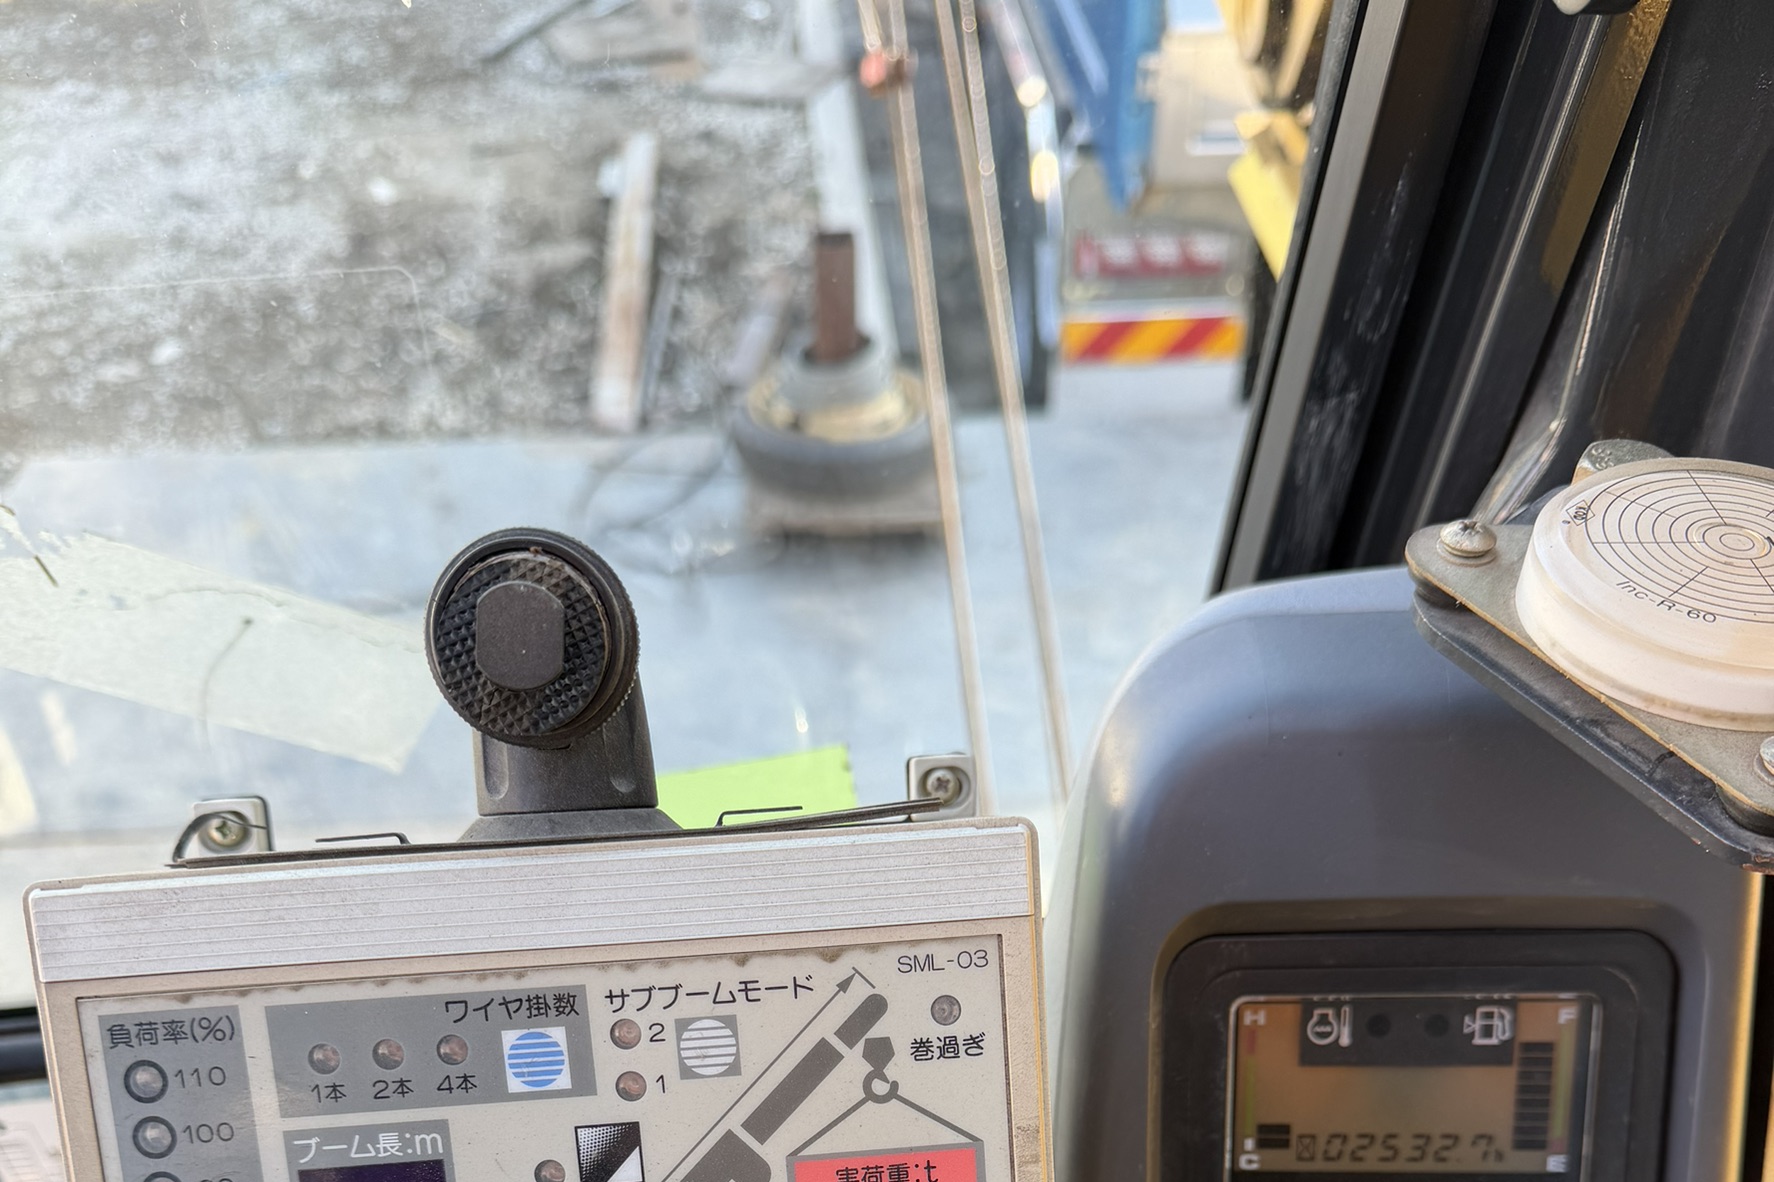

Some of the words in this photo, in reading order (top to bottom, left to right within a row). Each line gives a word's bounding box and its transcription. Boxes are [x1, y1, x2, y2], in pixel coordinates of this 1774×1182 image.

[1615, 580, 1718, 624] Inc-R-60
[897, 948, 989, 975] SML-03
[604, 974, 814, 1013] サブブームモード
[444, 992, 580, 1025] ワイヤ掛数
[1243, 1009, 1266, 1026] H
[106, 1014, 236, 1050] 負荷率(%)
[648, 1023, 666, 1042] 2
[909, 1031, 987, 1063] 巻過ぎ
[173, 1065, 227, 1089] 110
[372, 1077, 415, 1099] 2本
[436, 1073, 478, 1095] 4本
[655, 1074, 667, 1094] 1
[310, 1080, 347, 1104] 1本
[182, 1122, 235, 1145] 100
[293, 1131, 444, 1164] ブーム長:m
